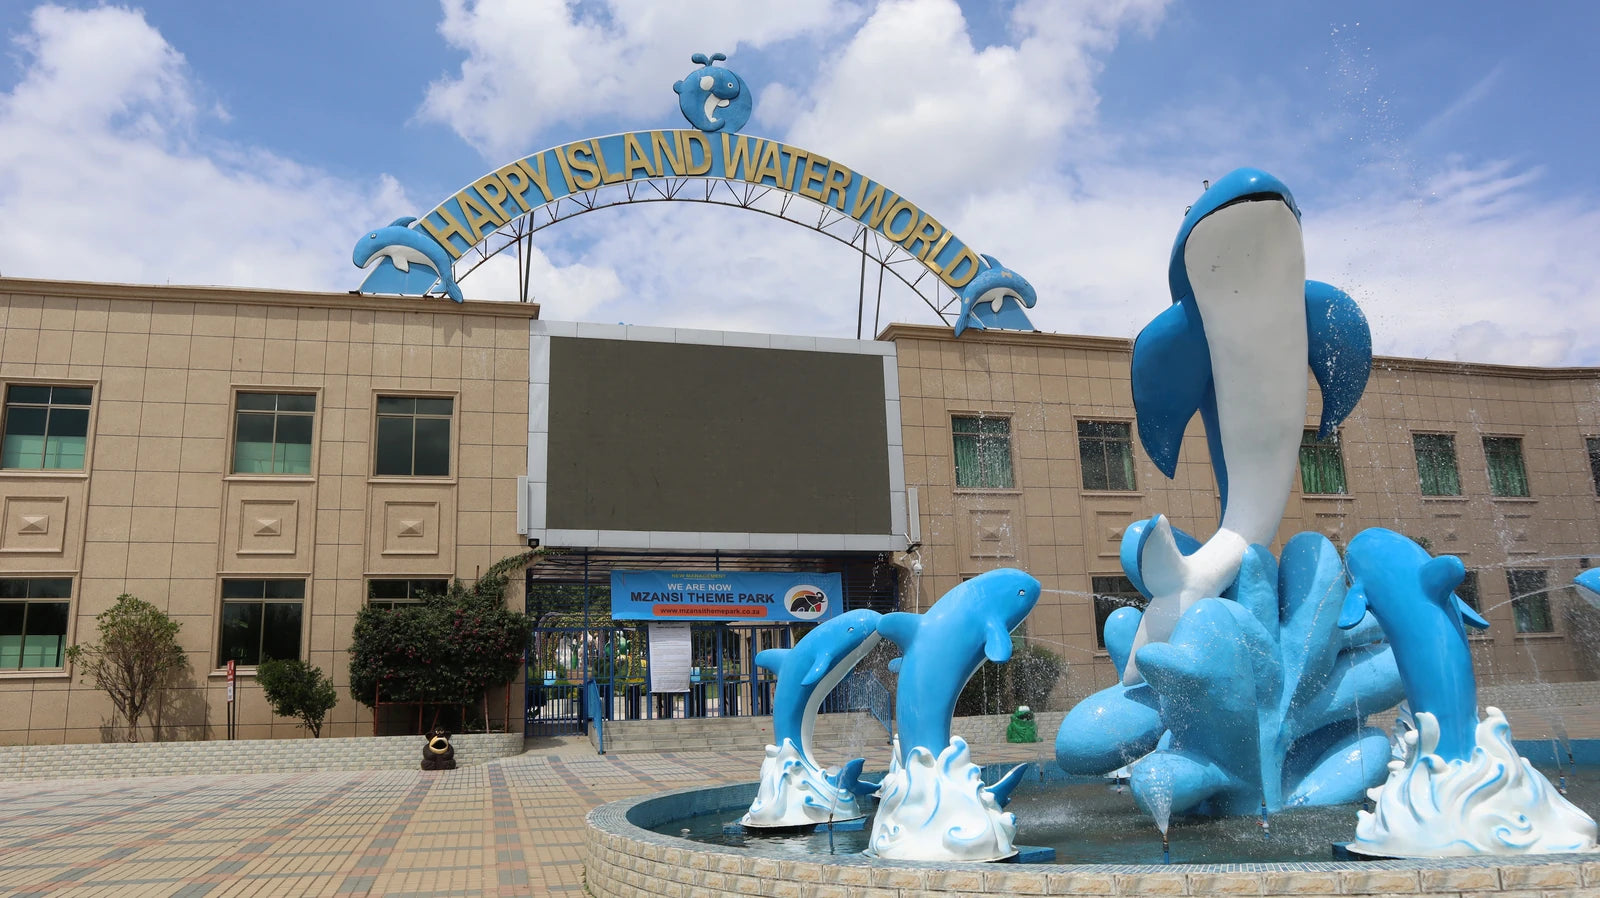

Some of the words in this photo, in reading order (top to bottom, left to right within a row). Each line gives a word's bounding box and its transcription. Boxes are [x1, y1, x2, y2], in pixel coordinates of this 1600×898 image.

[420, 151, 554, 260] HAPPY
[553, 129, 713, 194] ISLAND
[721, 132, 852, 211] WATER
[851, 175, 980, 289] WORLD
[667, 583, 683, 591] WE
[685, 583, 705, 591] ARE
[708, 584, 732, 592] NOW
[630, 591, 684, 603] MZANSI
[689, 592, 734, 603] THEME
[738, 593, 775, 604] PARK
[660, 607, 760, 616] www.mzansithemepark.co.za
